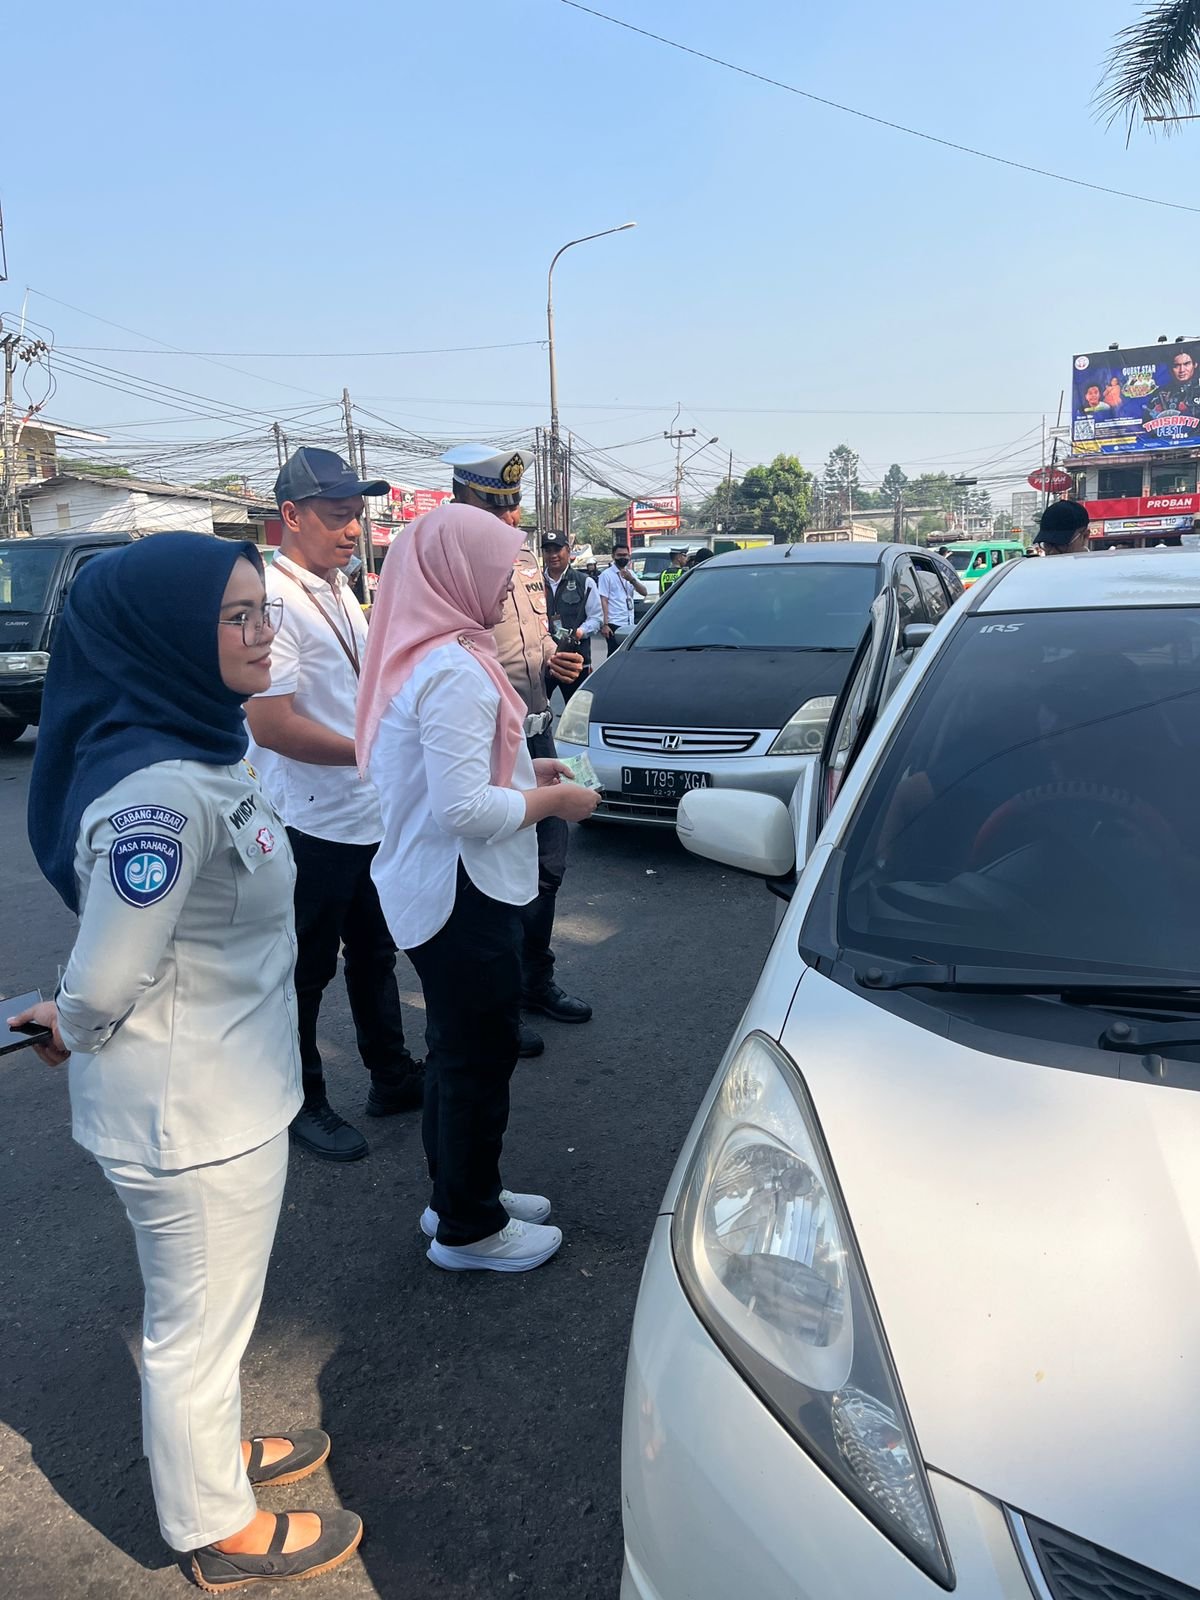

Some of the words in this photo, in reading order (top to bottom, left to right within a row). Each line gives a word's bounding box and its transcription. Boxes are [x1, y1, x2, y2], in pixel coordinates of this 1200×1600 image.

[1122, 366, 1140, 376] GUEST
[1141, 364, 1156, 374] STAR
[1157, 425, 1183, 437] FEST
[1146, 498, 1192, 508] PROBAN
[624, 769, 632, 785] D
[645, 770, 675, 788] 1795
[684, 773, 708, 789] XGA
[117, 810, 152, 827] CABANG
[152, 810, 181, 828] JABAR
[117, 841, 139, 855] JASA
[140, 840, 175, 858] RAHARJA
